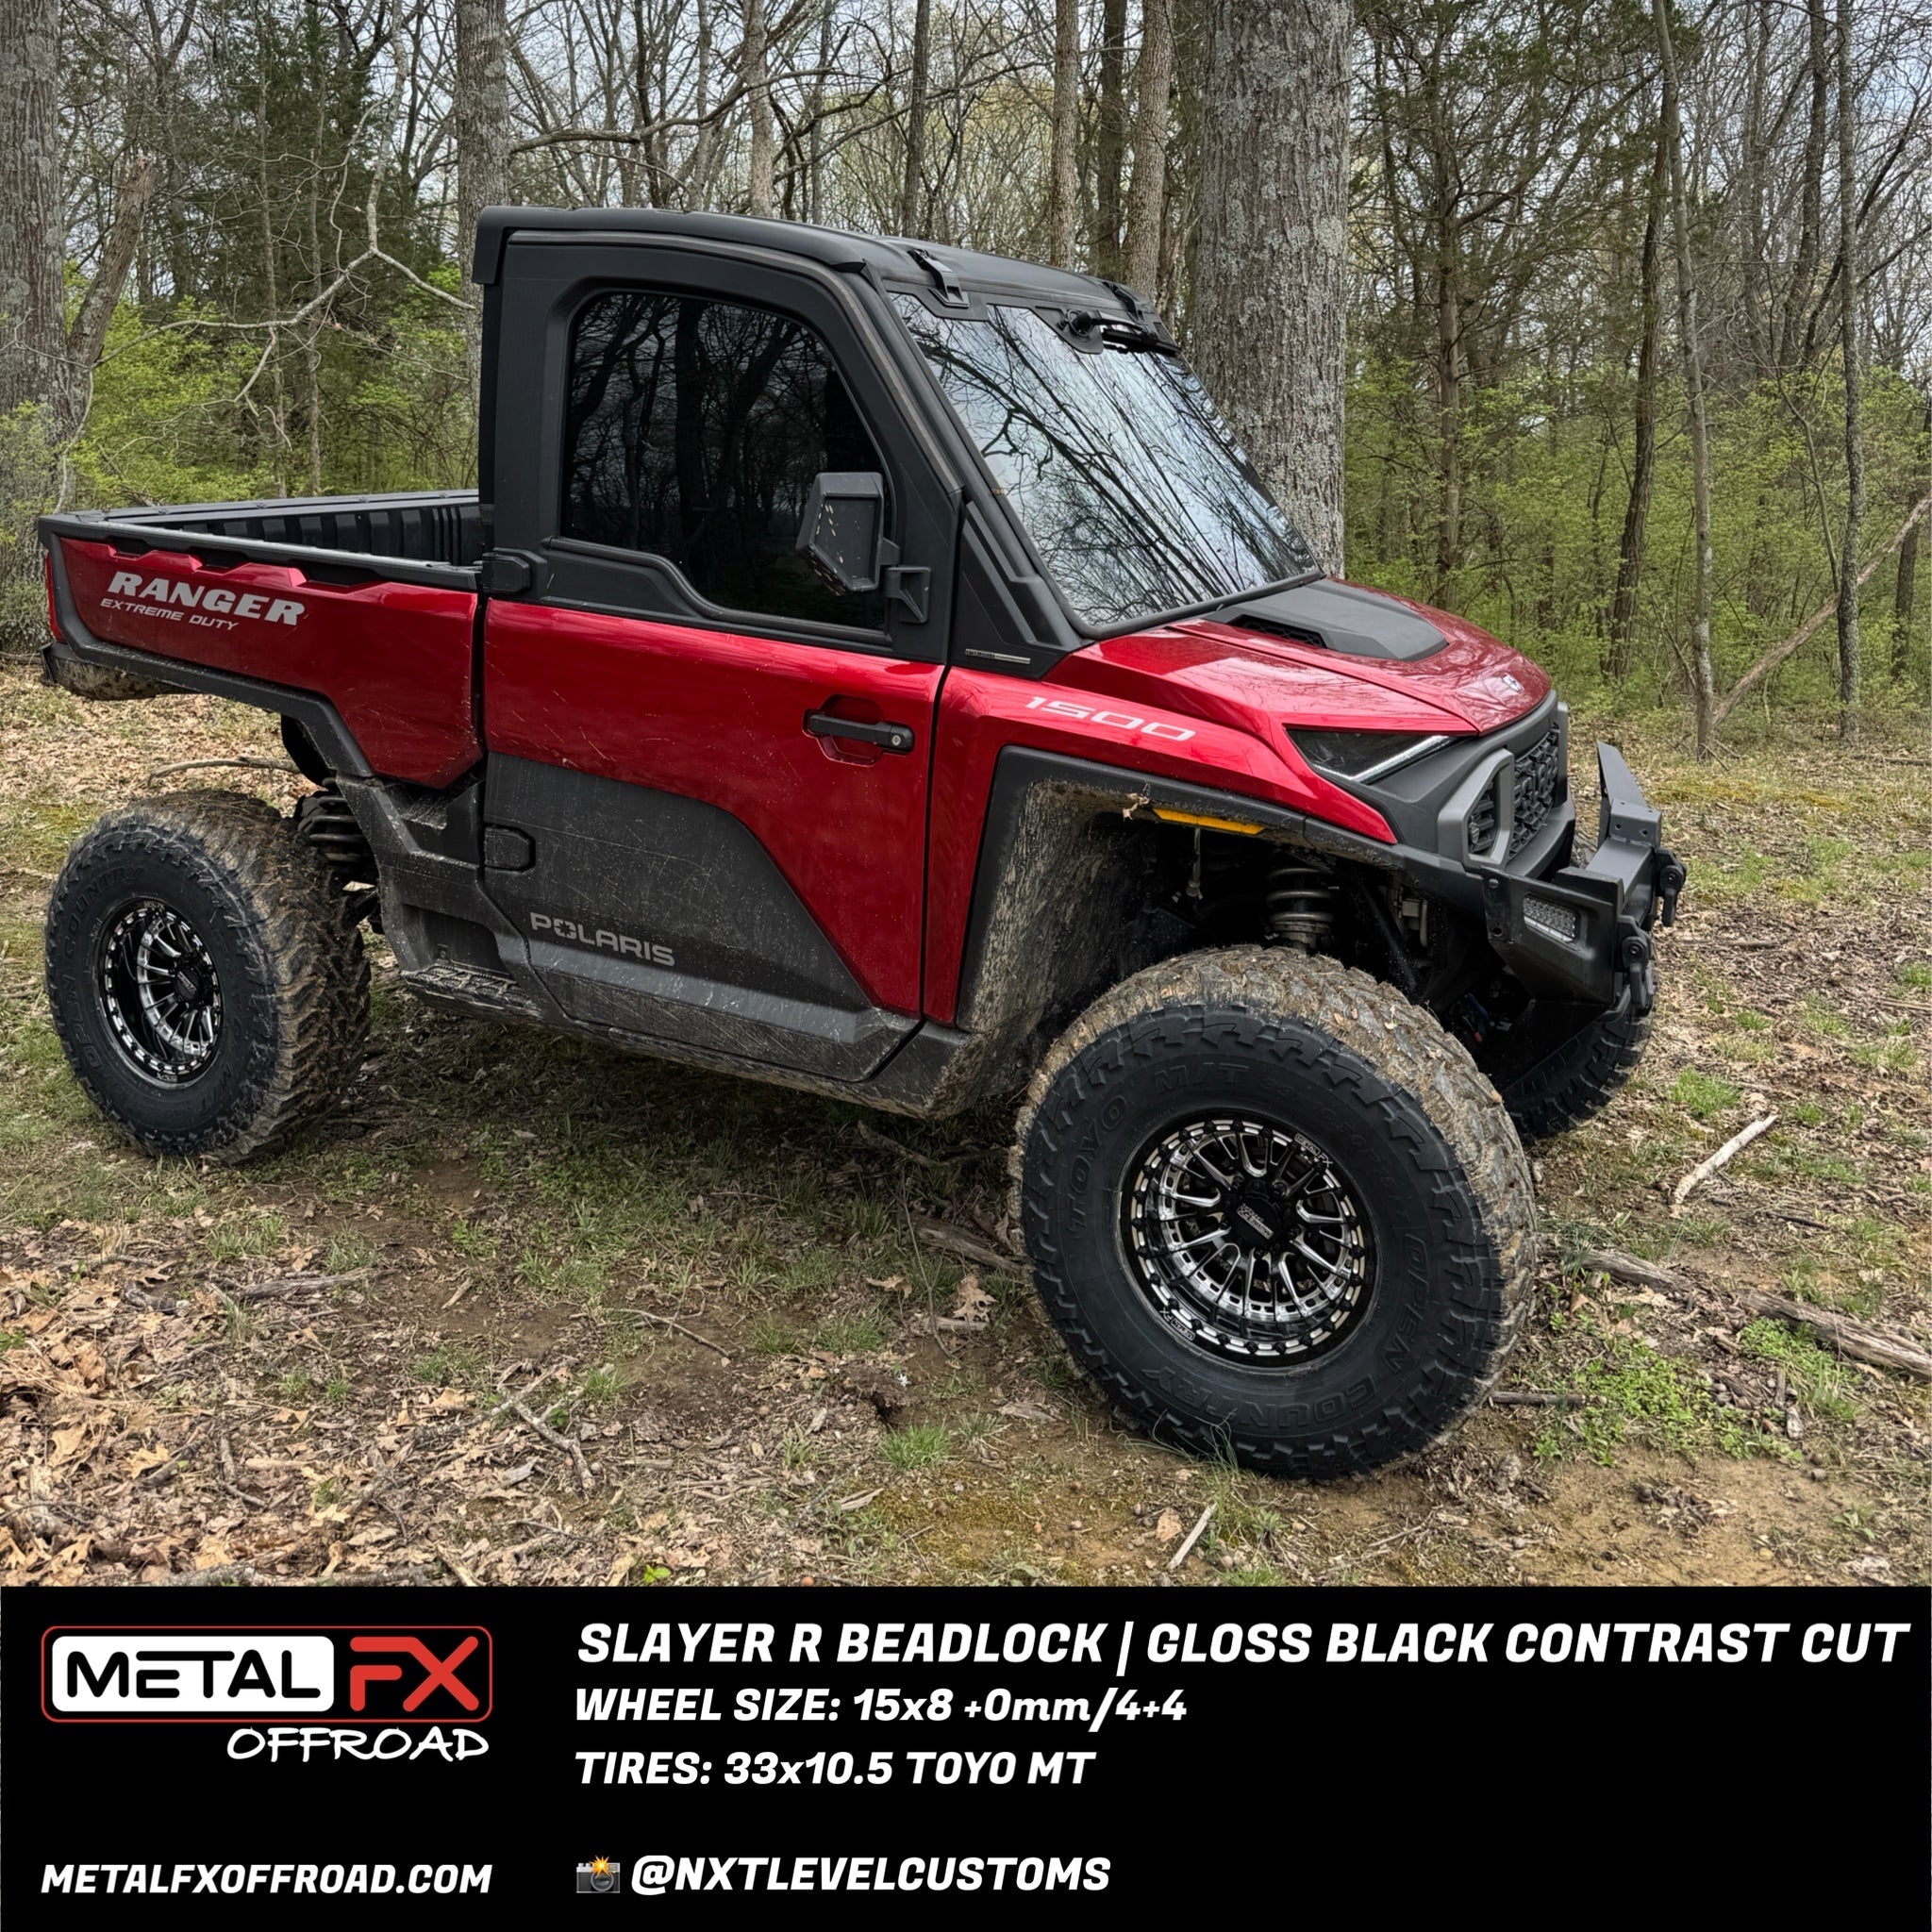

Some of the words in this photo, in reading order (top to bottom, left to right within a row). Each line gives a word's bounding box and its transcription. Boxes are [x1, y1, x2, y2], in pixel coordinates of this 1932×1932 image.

[100, 598, 184, 622] EXTREME
[189, 615, 239, 630] DUTY
[108, 571, 305, 626] RANGER
[1024, 696, 1196, 741] 1500
[66, 866, 145, 959] COUNTRY
[530, 912, 675, 967] POLARIS
[1066, 1094, 1129, 1234] TOYO
[1153, 1061, 1251, 1094] M/T
[1386, 1232, 1430, 1374] OPEN
[1140, 1364, 1378, 1432] COUNTRY
